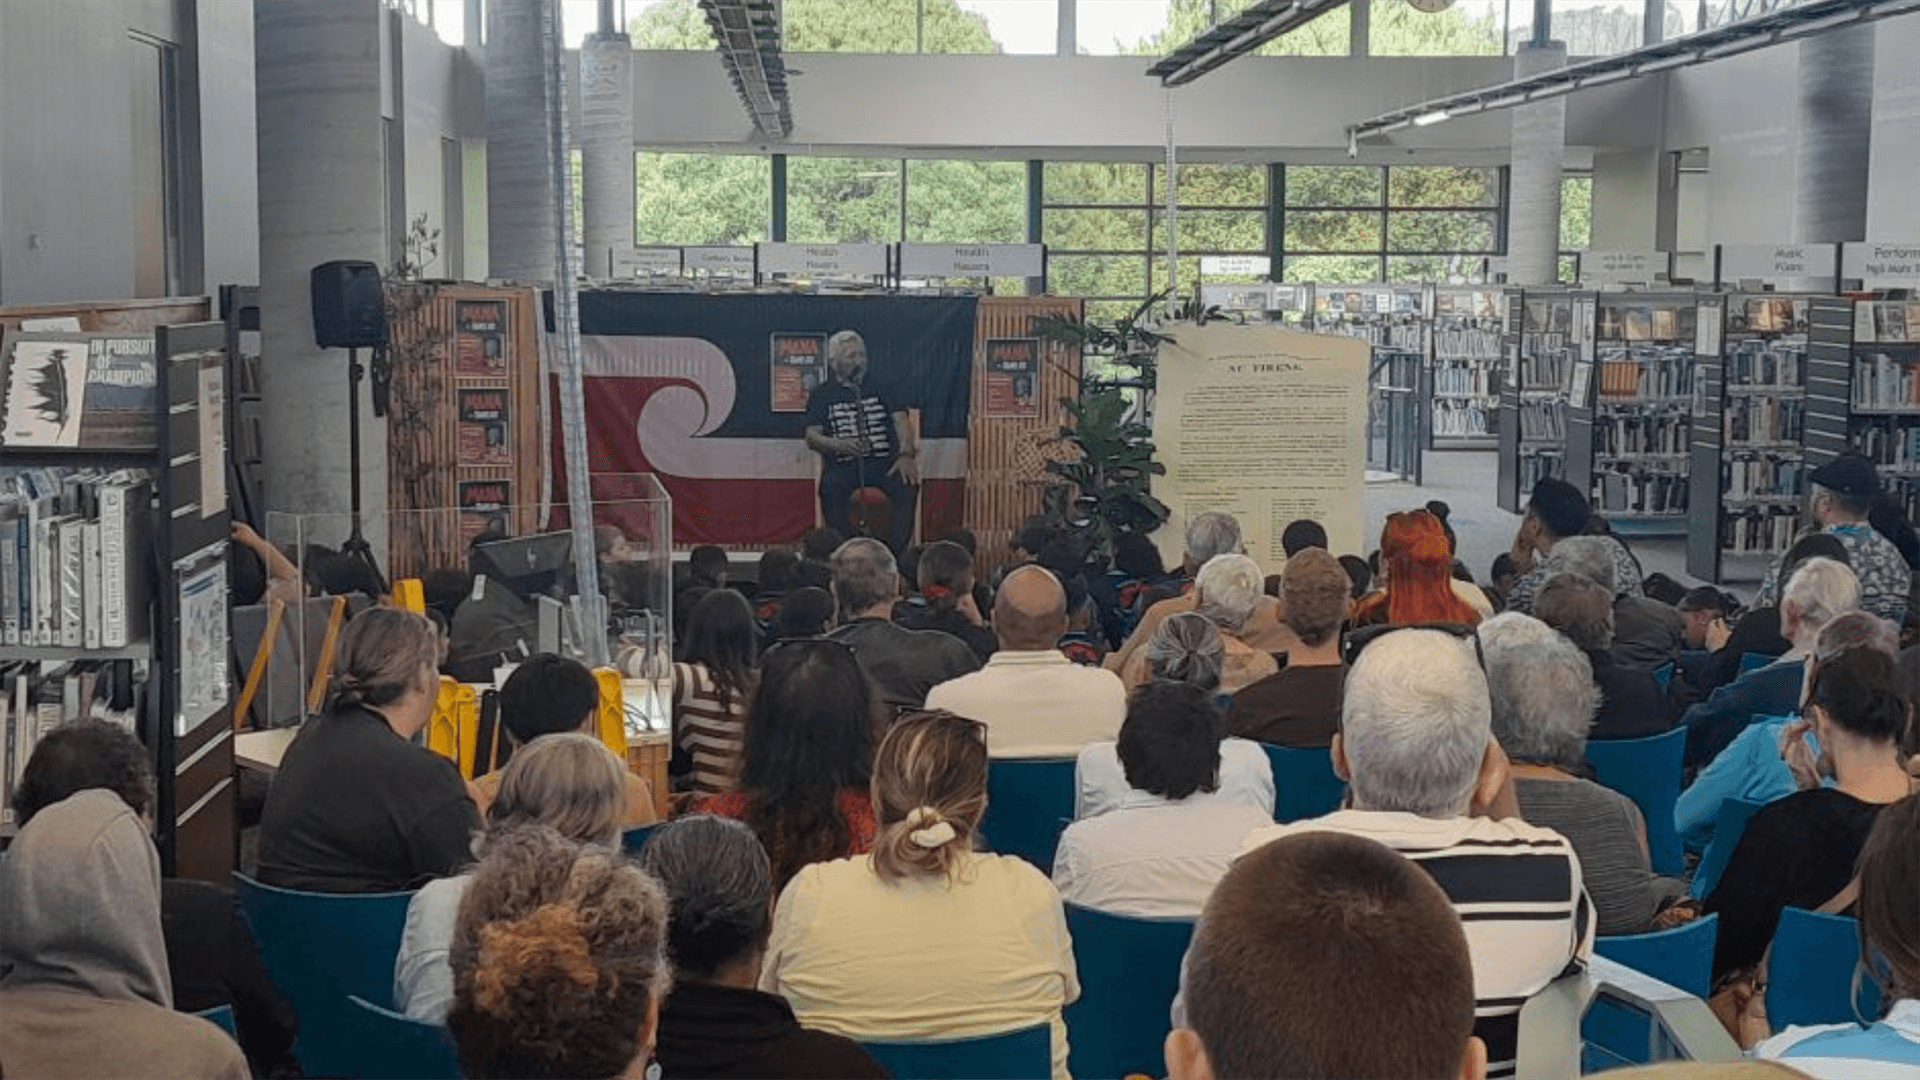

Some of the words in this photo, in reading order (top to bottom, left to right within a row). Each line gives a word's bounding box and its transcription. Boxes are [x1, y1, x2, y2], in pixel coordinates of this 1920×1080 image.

[806, 247, 838, 256] Health
[955, 247, 989, 256] Health
[1775, 248, 1804, 258] Music
[91, 339, 104, 354] IN
[106, 339, 156, 355] PURSUIT
[97, 355, 111, 369] OF
